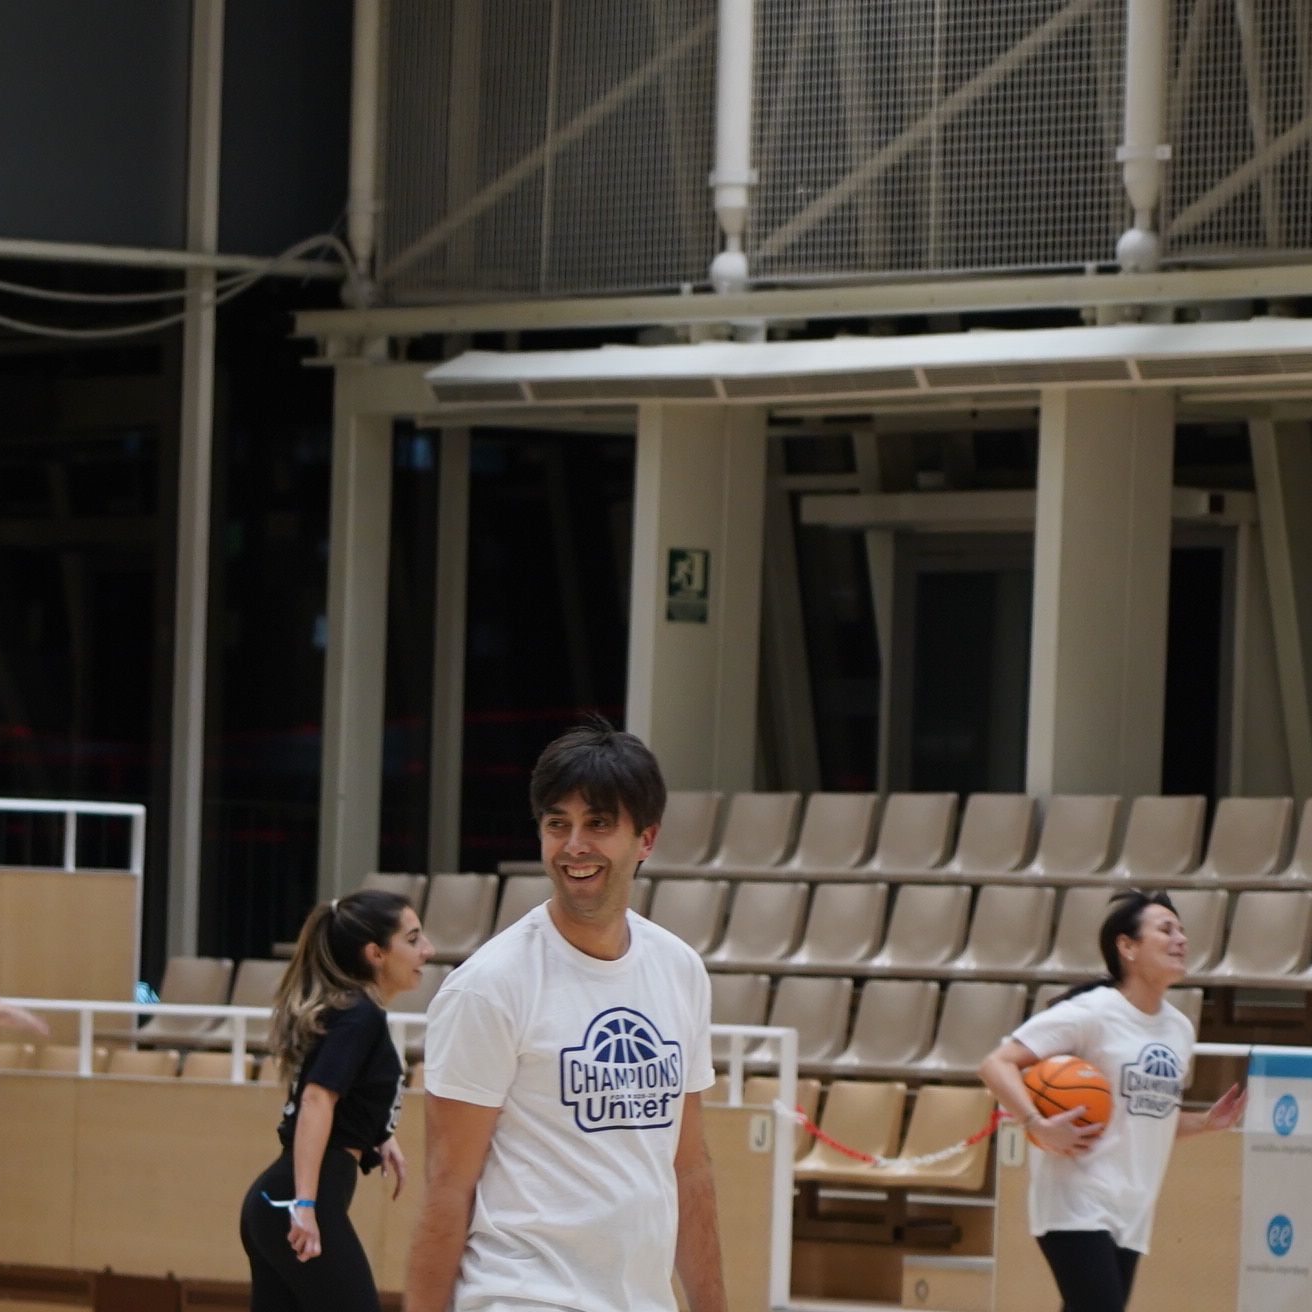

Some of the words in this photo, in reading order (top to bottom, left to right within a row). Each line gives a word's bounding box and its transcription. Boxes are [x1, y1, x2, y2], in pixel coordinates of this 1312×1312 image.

[570, 1052, 680, 1094] CHAMPIONS
[586, 1092, 671, 1122] Unicef
[754, 1119, 767, 1148] J
